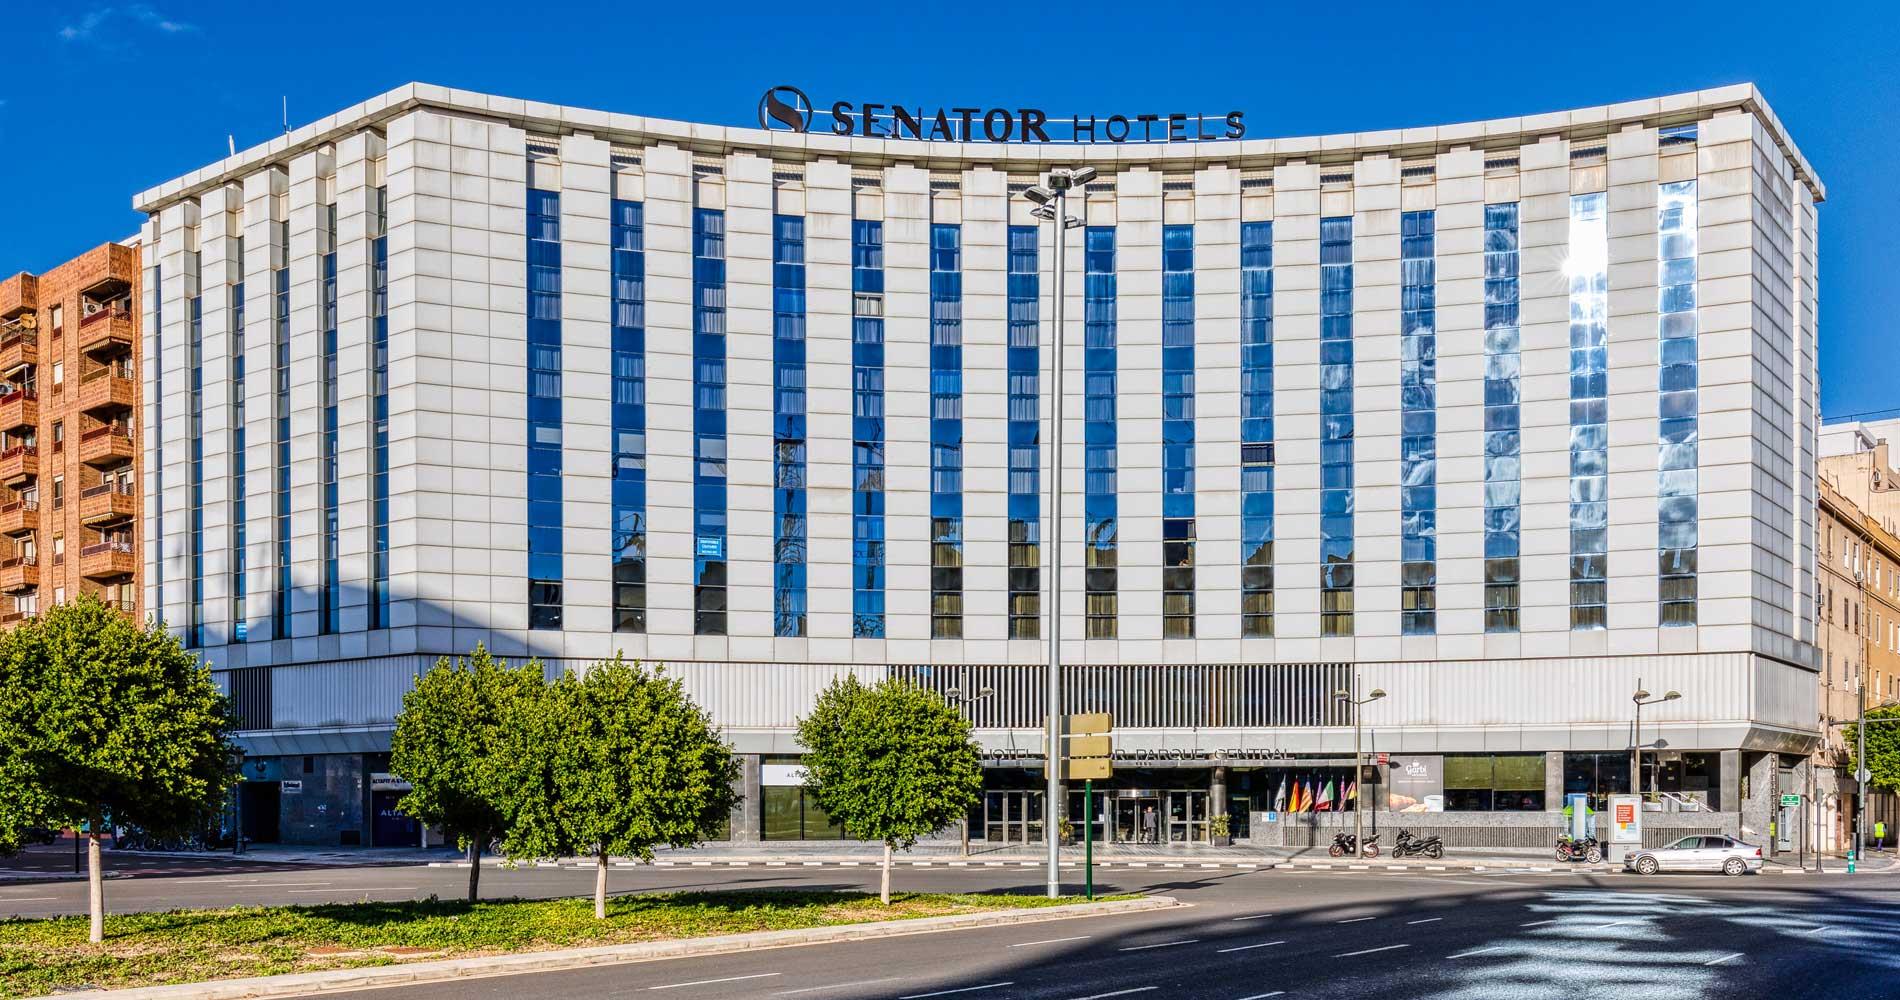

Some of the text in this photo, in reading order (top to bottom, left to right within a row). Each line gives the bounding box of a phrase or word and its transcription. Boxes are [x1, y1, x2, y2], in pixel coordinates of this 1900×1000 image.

[832, 101, 1246, 144] SENATOR HOTELS
[980, 748, 1037, 760] HOTEL
[1136, 748, 1205, 760] PARQUE
[1214, 748, 1295, 760] CENTRAL
